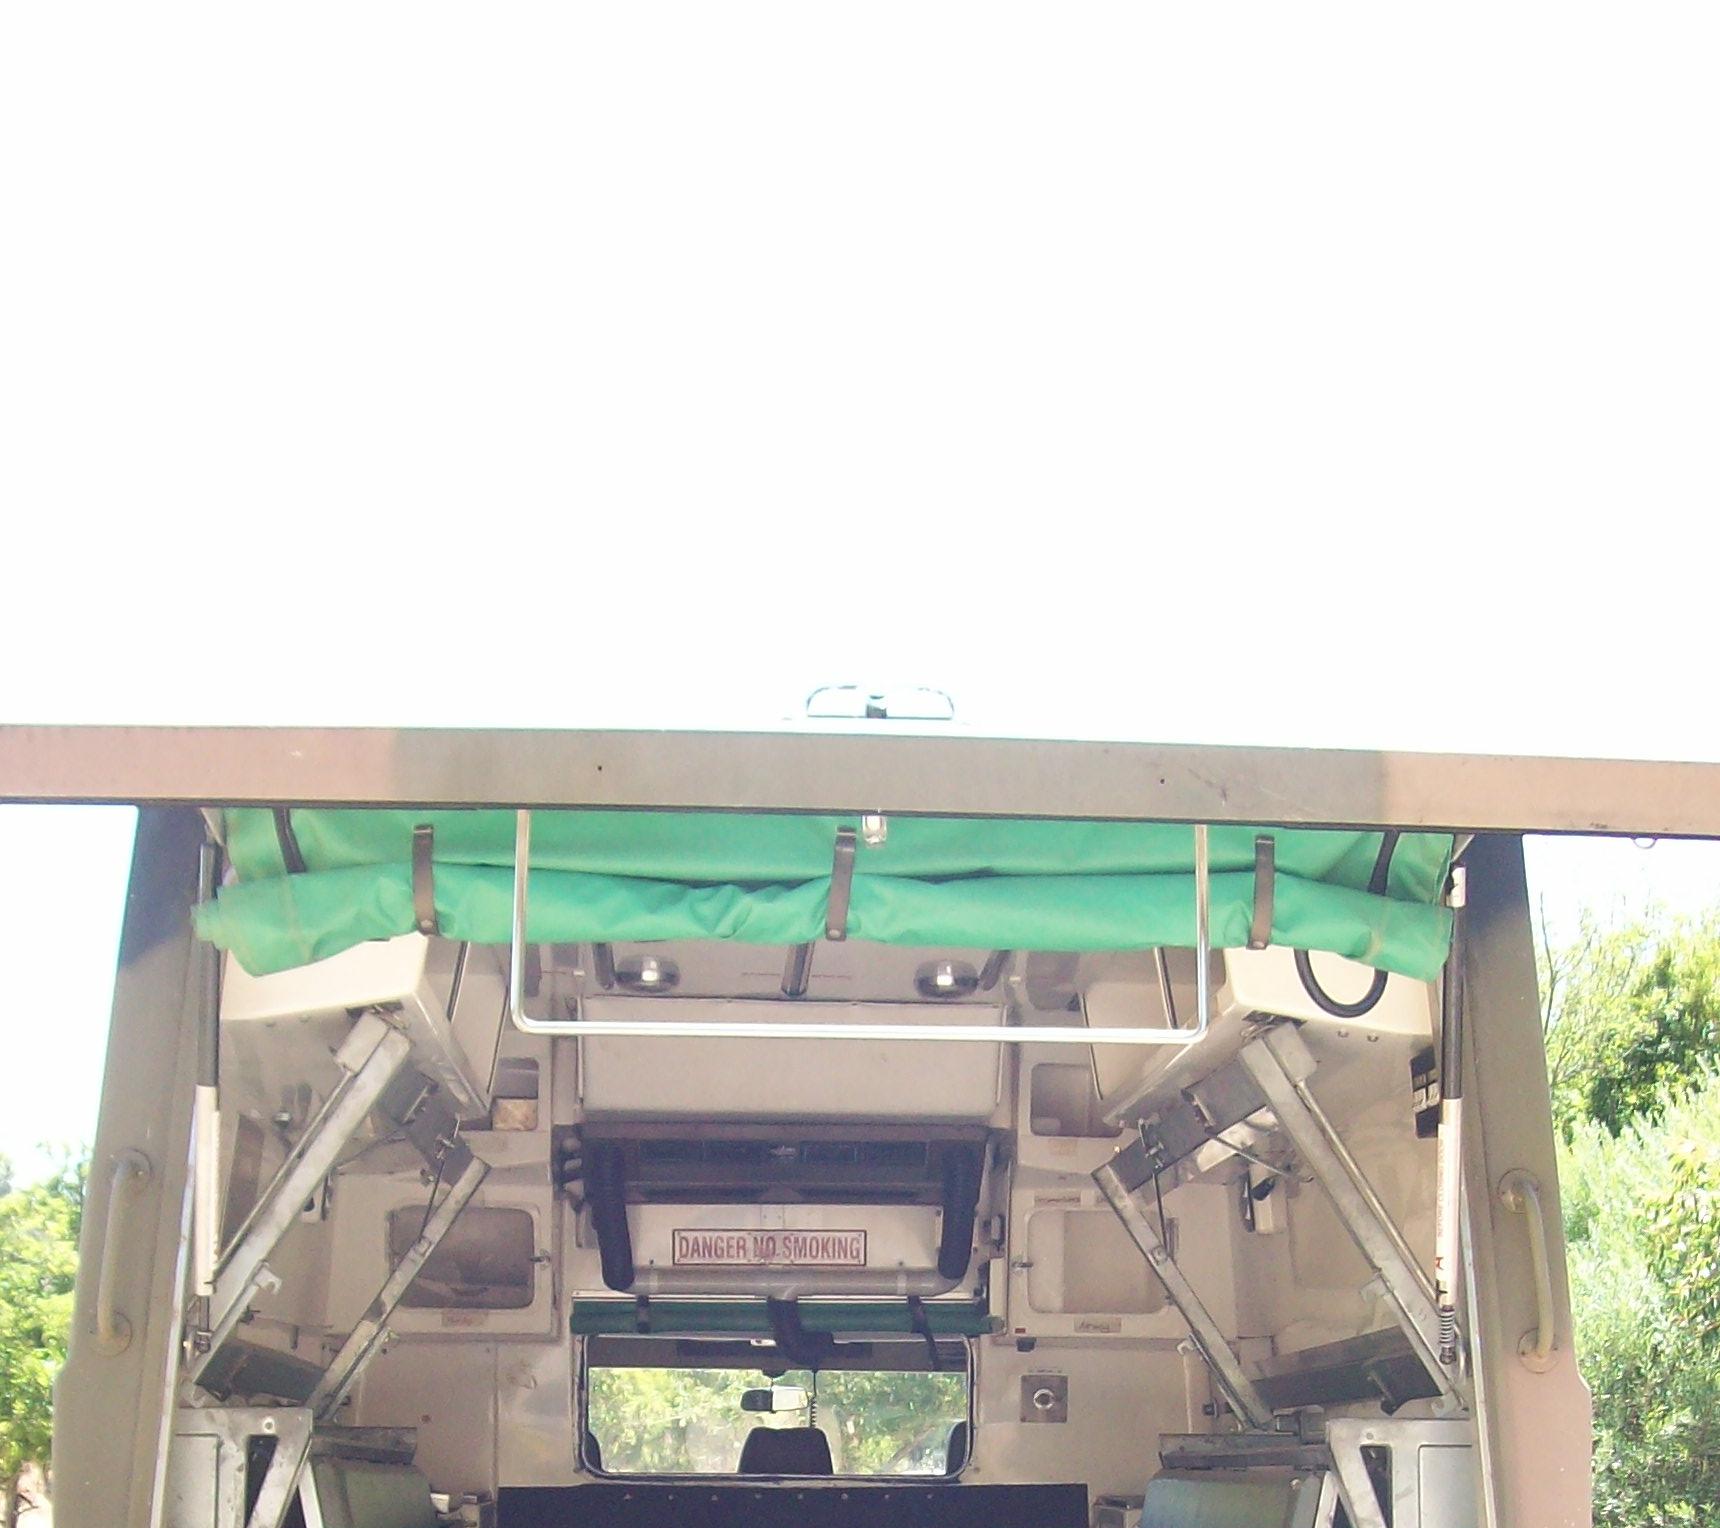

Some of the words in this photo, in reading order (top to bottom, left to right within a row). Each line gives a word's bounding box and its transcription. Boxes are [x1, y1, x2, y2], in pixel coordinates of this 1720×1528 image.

[678, 1235, 747, 1259] DANGER
[753, 1236, 777, 1259] NO
[782, 1236, 861, 1260] SMOKING
